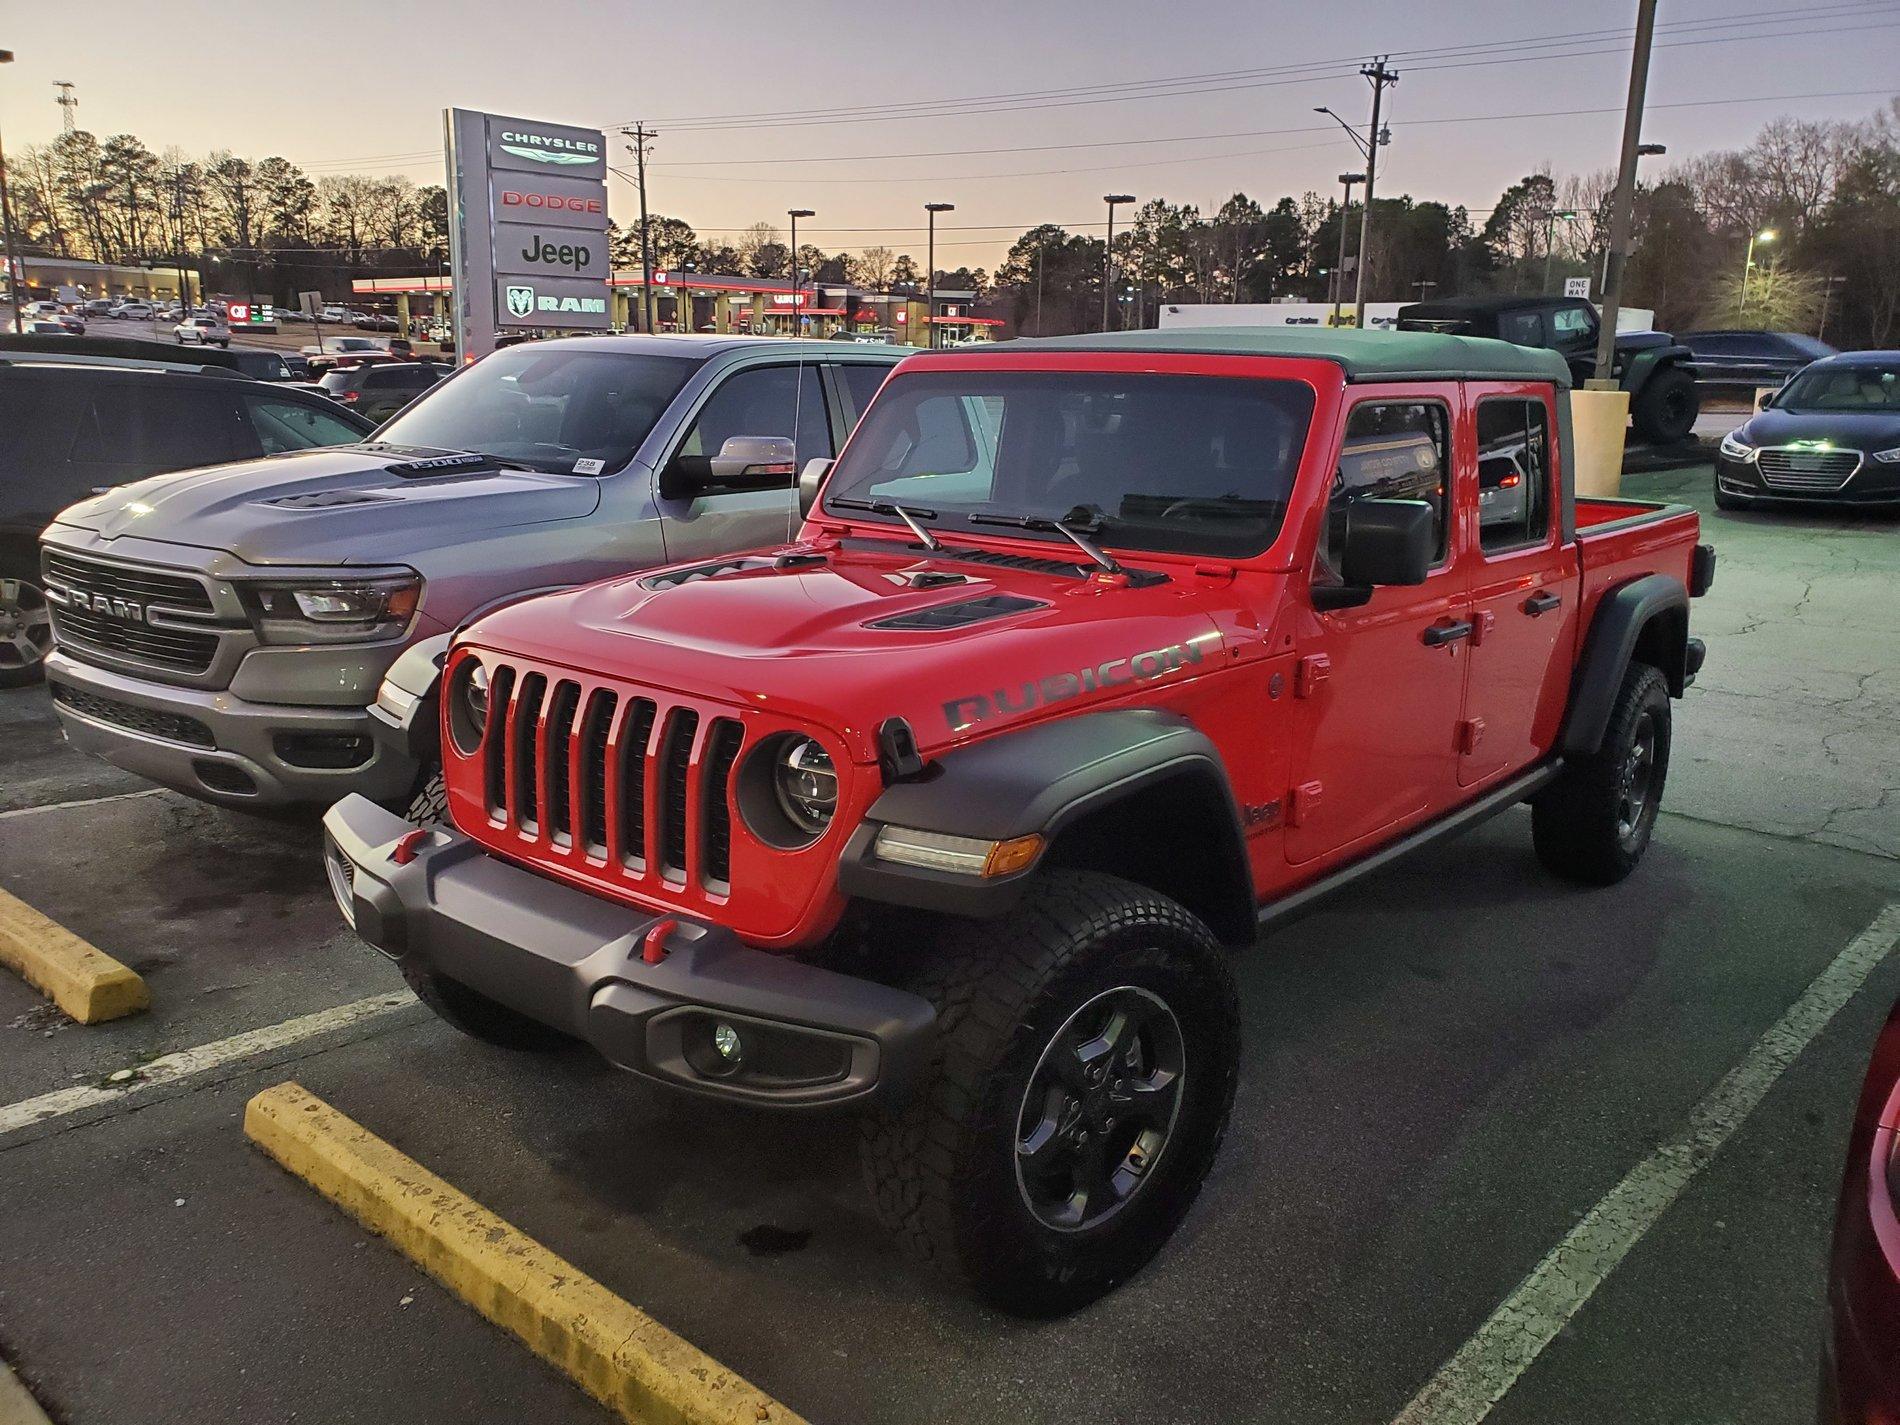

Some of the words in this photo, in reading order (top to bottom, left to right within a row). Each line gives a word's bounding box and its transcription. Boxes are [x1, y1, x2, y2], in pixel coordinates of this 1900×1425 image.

[501, 132, 598, 152] CHRYSLER
[502, 191, 602, 214] DODGE
[522, 235, 591, 271] Jeep
[1568, 289, 1586, 297] WAY
[1569, 280, 1587, 288] ONE
[537, 296, 606, 313] RAM
[409, 457, 461, 470] 1500
[69, 588, 143, 622] RAM
[942, 639, 1204, 732] RUBICON
